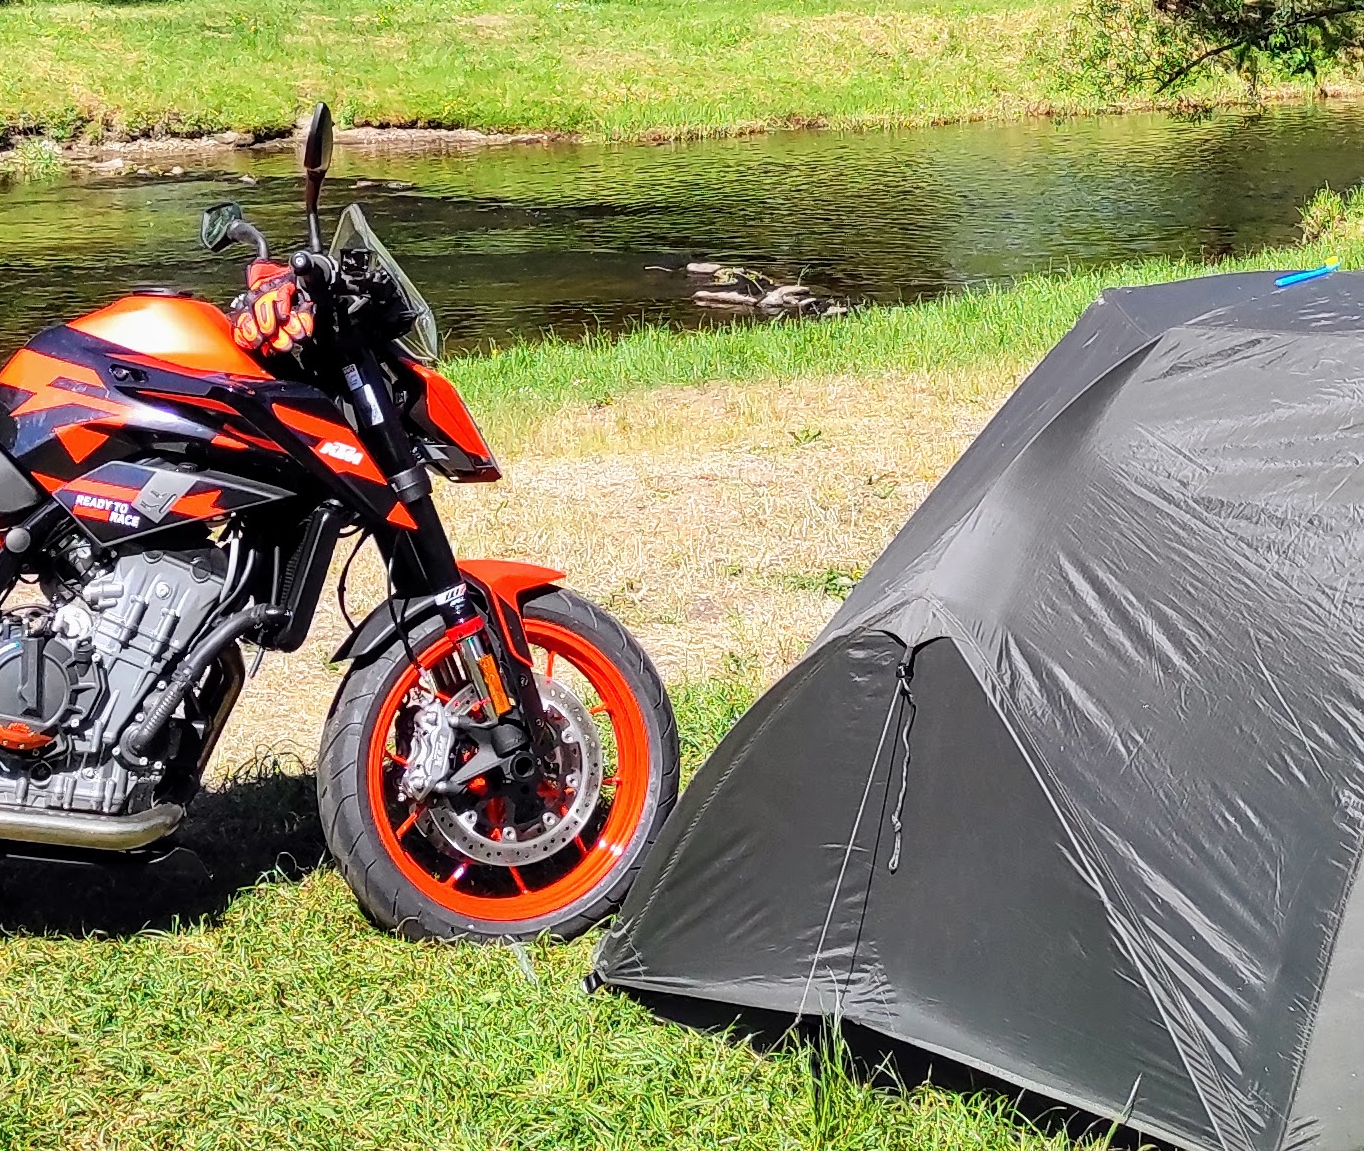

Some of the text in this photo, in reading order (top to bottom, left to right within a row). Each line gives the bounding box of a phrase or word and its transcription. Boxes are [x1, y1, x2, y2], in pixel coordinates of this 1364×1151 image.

[319, 441, 363, 466] KTM
[75, 494, 129, 514] READY TO
[109, 510, 140, 529] RACE
